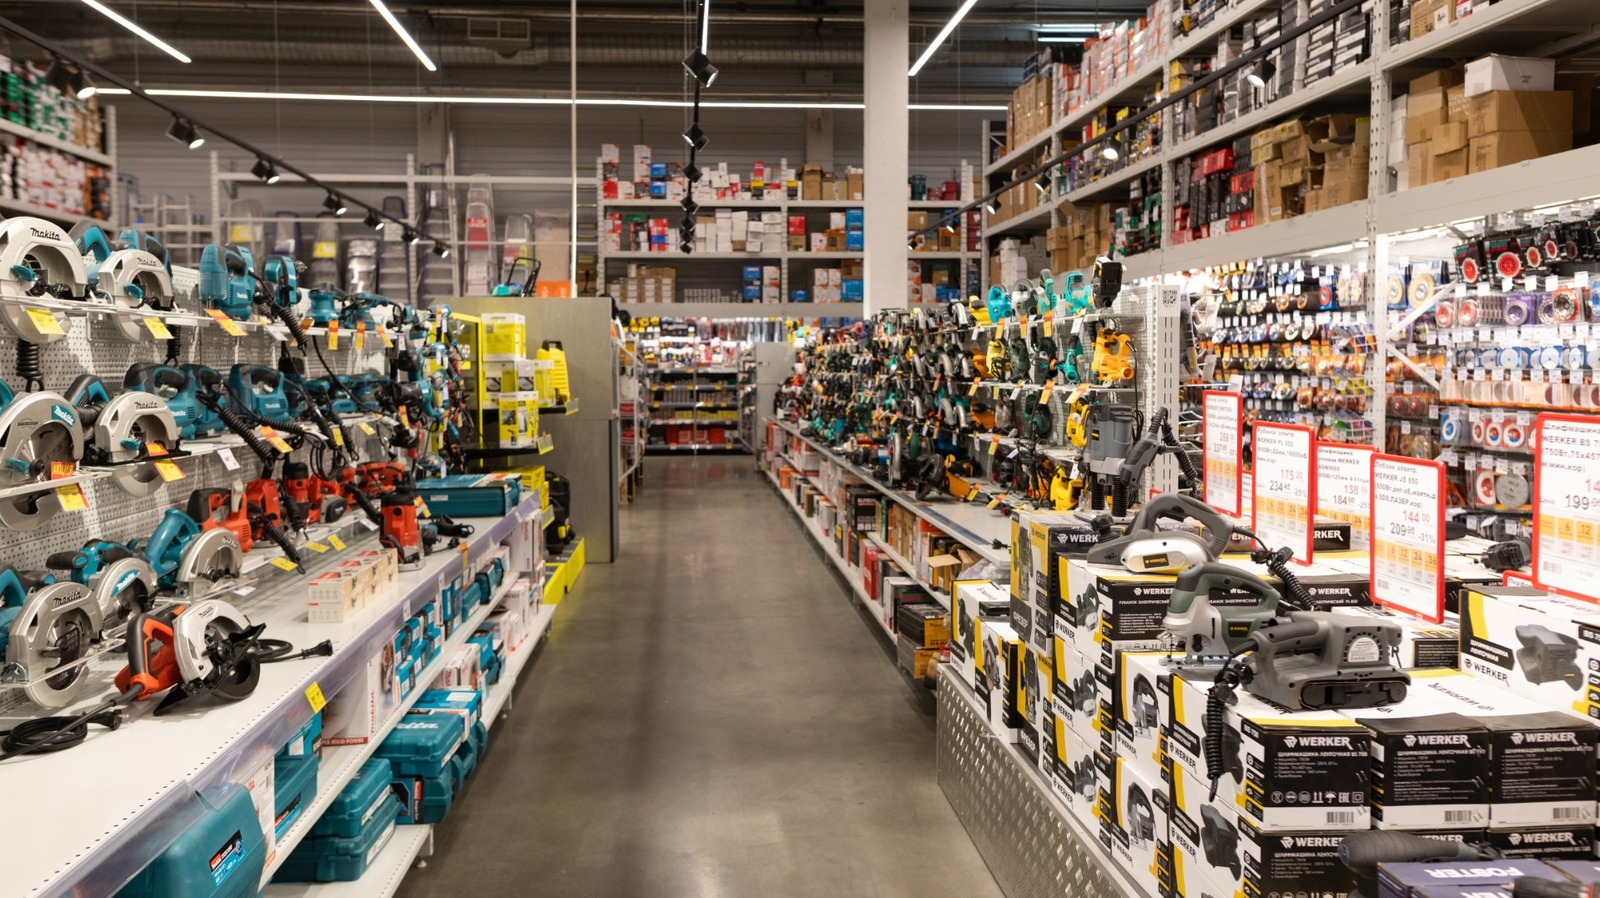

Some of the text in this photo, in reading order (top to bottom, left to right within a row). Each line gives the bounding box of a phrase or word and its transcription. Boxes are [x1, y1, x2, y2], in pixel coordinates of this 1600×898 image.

[1542, 435, 1577, 445] WERKER
[1580, 439, 1591, 447] BS
[1280, 468, 1295, 481] 175
[1375, 473, 1398, 481] WERKER
[1269, 480, 1283, 492] 234
[1344, 484, 1359, 495] 138
[1333, 494, 1347, 506] 184
[1565, 494, 1590, 510] 199
[1402, 509, 1431, 524] 144 00
[1390, 522, 1407, 536] 209
[1418, 533, 1435, 544] -31%
[1565, 522, 1592, 536] 6 12
[1070, 533, 1099, 543] WERK
[1314, 530, 1344, 542] RKER
[1401, 548, 1408, 558] 12
[1414, 552, 1423, 561] 24
[1429, 555, 1437, 565] 36
[1316, 588, 1352, 597] WERKER
[1059, 623, 1075, 644] WERKER
[1474, 663, 1510, 688] WERKER
[1057, 704, 1074, 727] WERKER
[1298, 736, 1353, 750] WERKER
[1417, 735, 1472, 748] WERKER
[1525, 732, 1579, 745] WERKER
[1175, 748, 1197, 774] WERKER
[1056, 781, 1074, 809] WERKER
[1523, 832, 1576, 845] WERKER
[1176, 833, 1198, 864] WERKER
[1425, 866, 1525, 879] FOSTER
